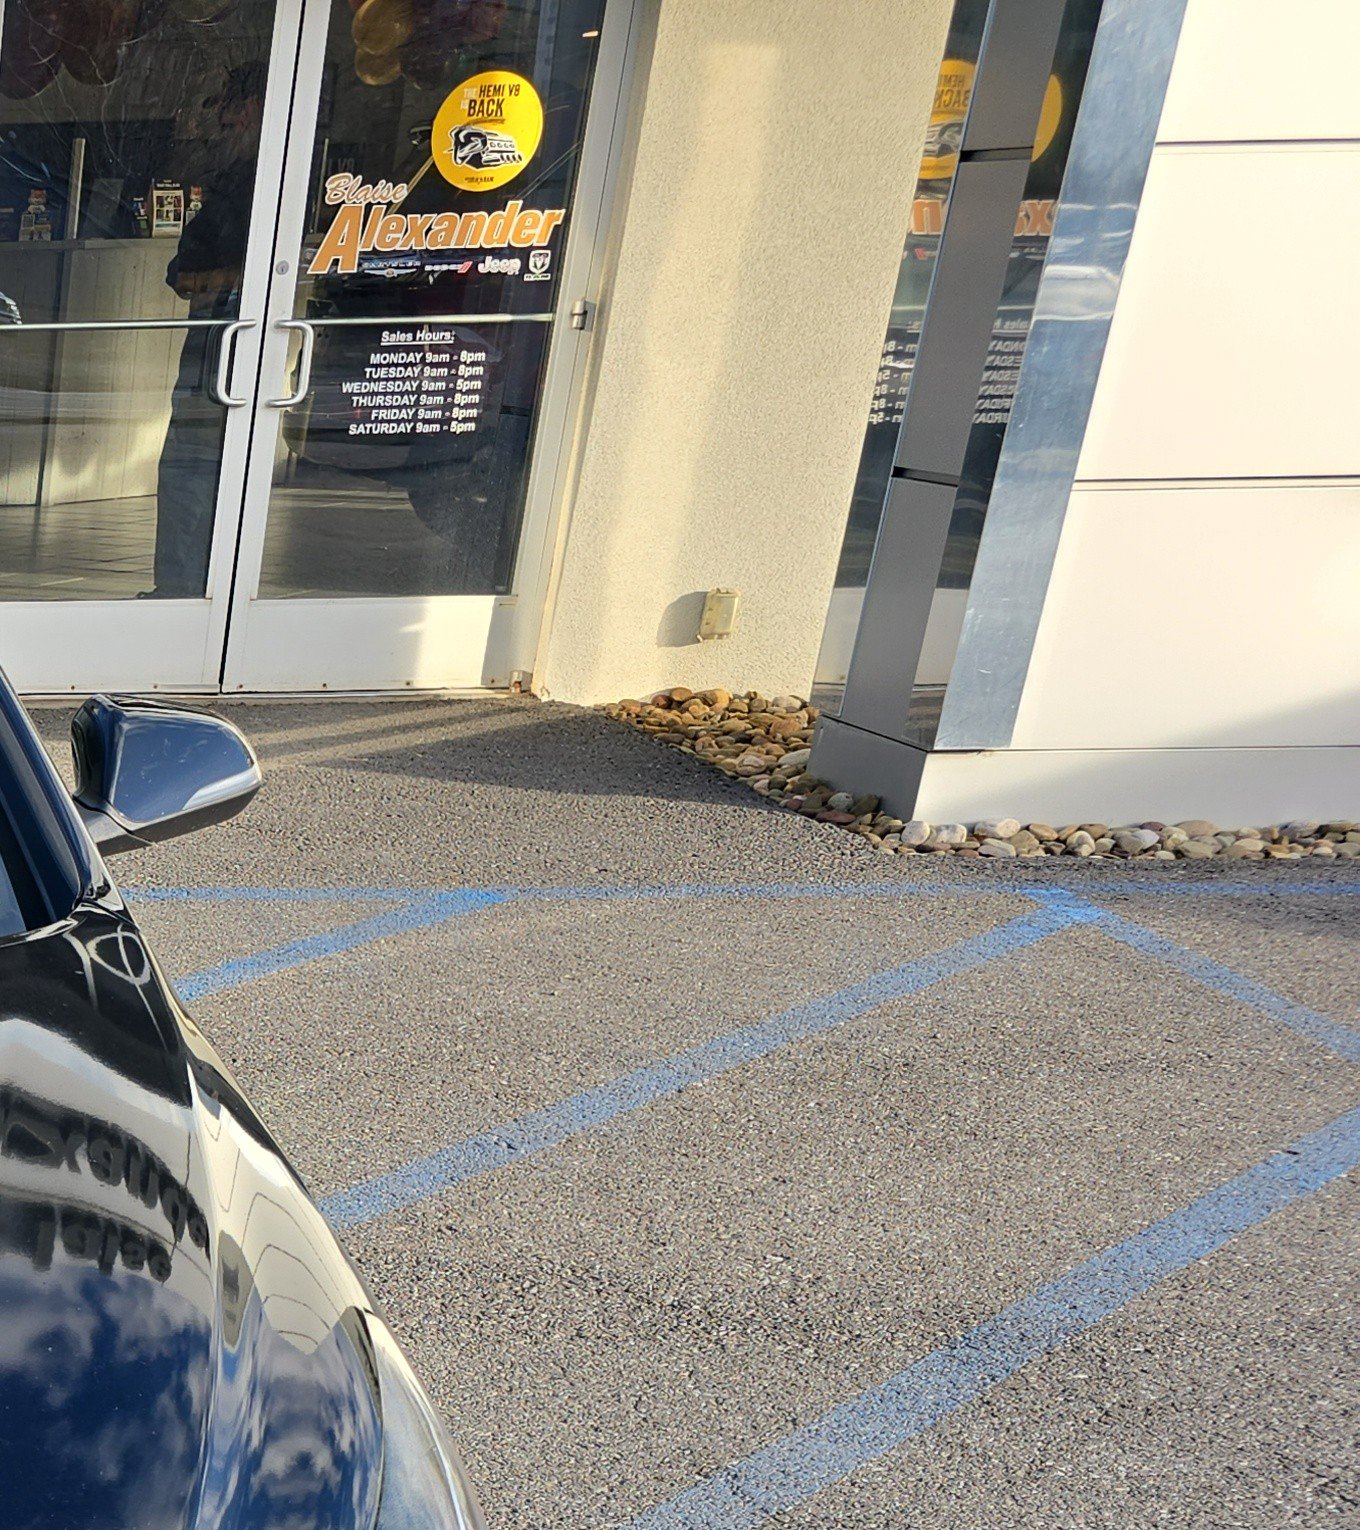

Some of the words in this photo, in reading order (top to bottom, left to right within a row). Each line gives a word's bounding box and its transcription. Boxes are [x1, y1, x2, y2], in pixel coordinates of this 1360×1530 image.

[479, 84, 505, 98] HEMI
[508, 84, 520, 97] V8
[467, 98, 505, 117] BACK
[325, 173, 408, 204] Blaise
[307, 200, 565, 274] Alexander
[477, 256, 521, 275] Jeep
[381, 331, 413, 342] Sales
[416, 330, 455, 342] Hours:
[370, 352, 423, 364] MONDAY
[425, 352, 450, 363] 9am
[460, 350, 486, 364] 8pm
[364, 367, 421, 379] TUESDAY
[423, 366, 448, 377] 9am
[458, 365, 484, 378] 8pm
[342, 381, 420, 393] WEDNESDAY
[421, 380, 446, 391] 9am
[456, 379, 482, 393] 5pm
[351, 395, 417, 407] THURSDAY
[419, 394, 444, 405] 9am
[454, 393, 480, 407] 8pm
[371, 409, 415, 420] FRIDAY
[417, 408, 442, 419] 9am
[452, 407, 477, 420] 8pm
[349, 423, 413, 435] SATURDAY
[415, 422, 440, 433] 9am
[450, 421, 475, 434] 5pm
